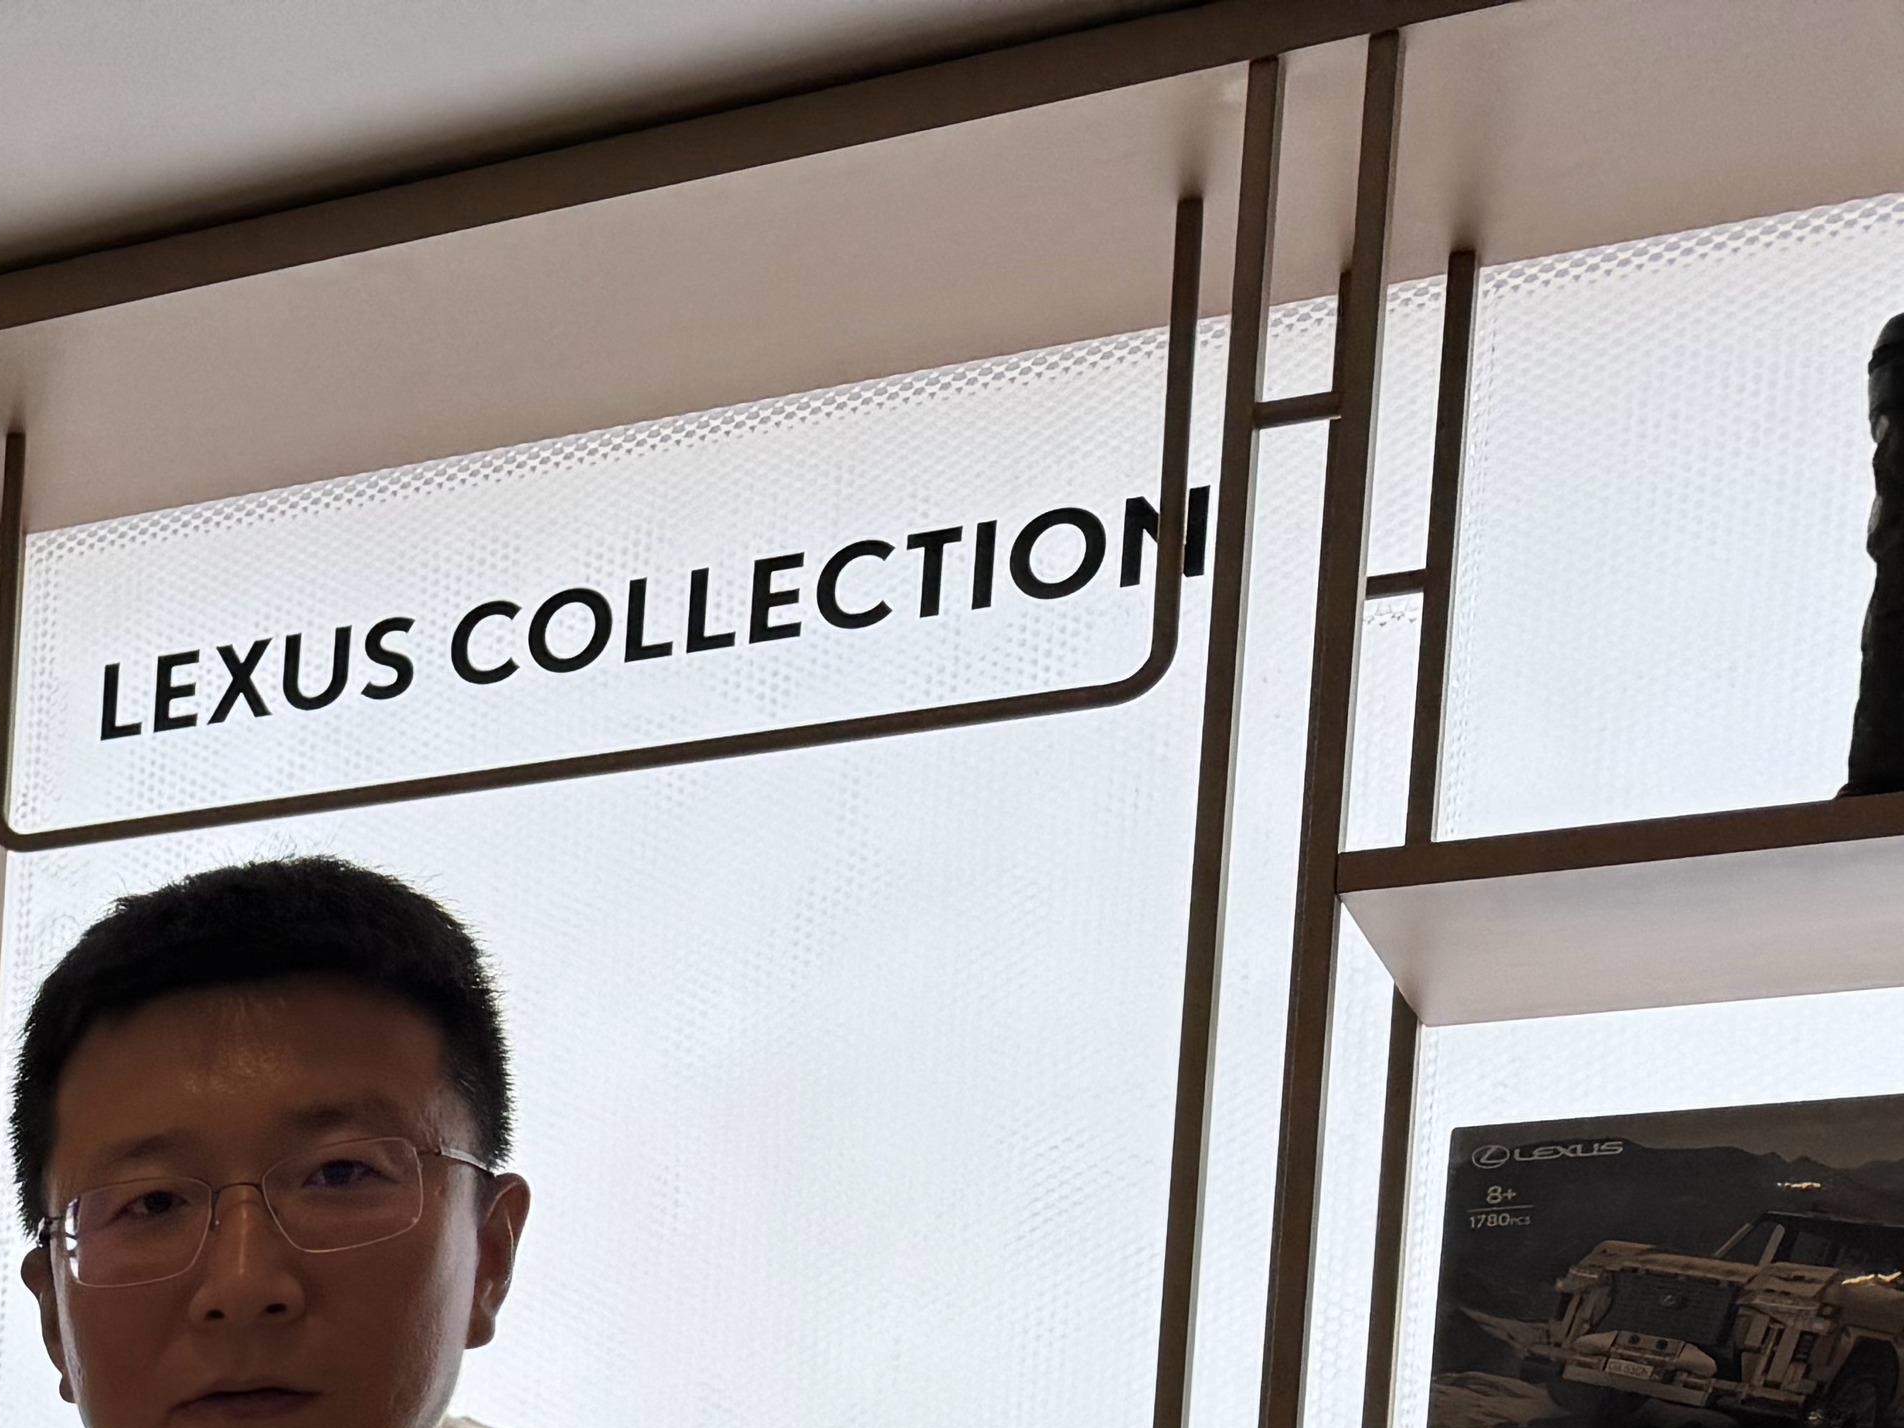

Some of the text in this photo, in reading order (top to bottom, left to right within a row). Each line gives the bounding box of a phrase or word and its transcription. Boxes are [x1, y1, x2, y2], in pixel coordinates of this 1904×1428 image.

[98, 485, 1210, 742] LEXUS COLLECTION
[1513, 1141, 1624, 1162] LEXUS
[1486, 1185, 1516, 1204] 8+
